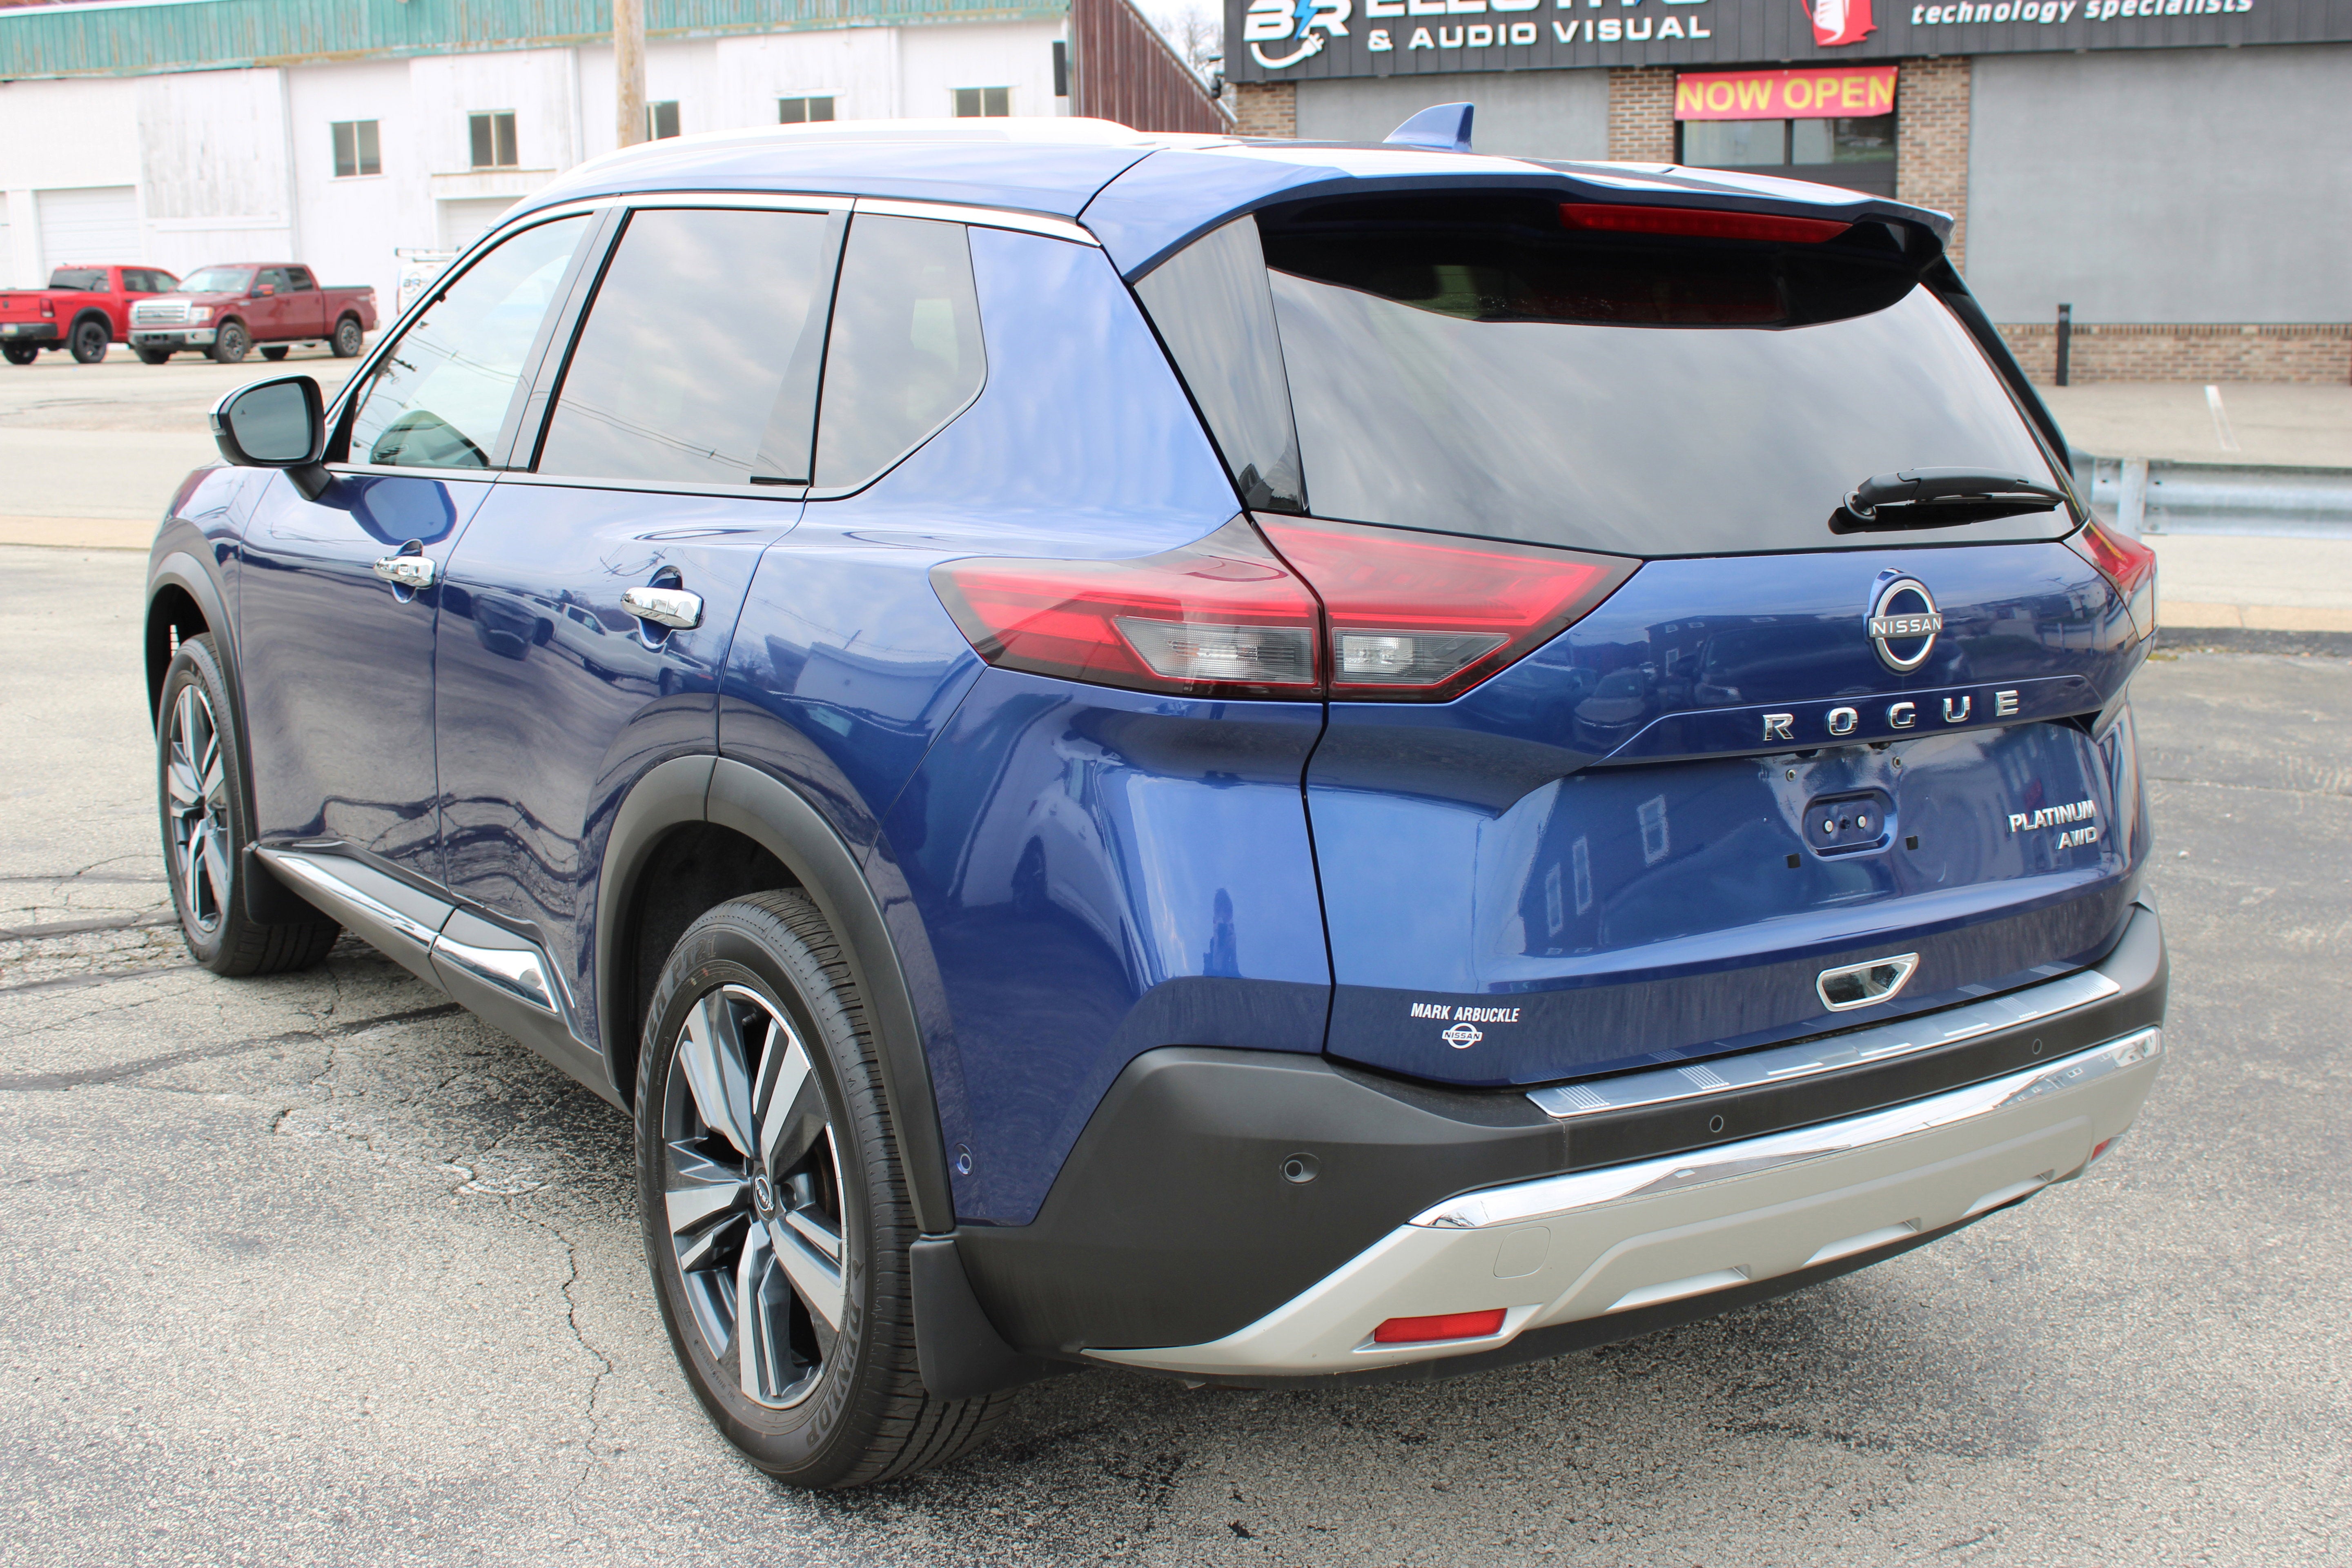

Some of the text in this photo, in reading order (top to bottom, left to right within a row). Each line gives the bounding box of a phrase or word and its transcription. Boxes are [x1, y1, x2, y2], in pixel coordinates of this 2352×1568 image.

[1911, 0, 2253, 25] technology specialists
[1368, 15, 1711, 51] & AUDIO VISUAL
[1677, 75, 1895, 112] NOW OPEN
[1872, 616, 1942, 635] NISSAN
[1762, 689, 2019, 741] ROGUE
[2007, 799, 2098, 833] PLATINUM
[2056, 826, 2099, 850] AWD
[671, 935, 717, 990] PT21
[1410, 1002, 1520, 1022] MARK ARBUCKLE
[1444, 1031, 1480, 1040] NISSAN
[806, 1294, 861, 1448] DUNLOP
